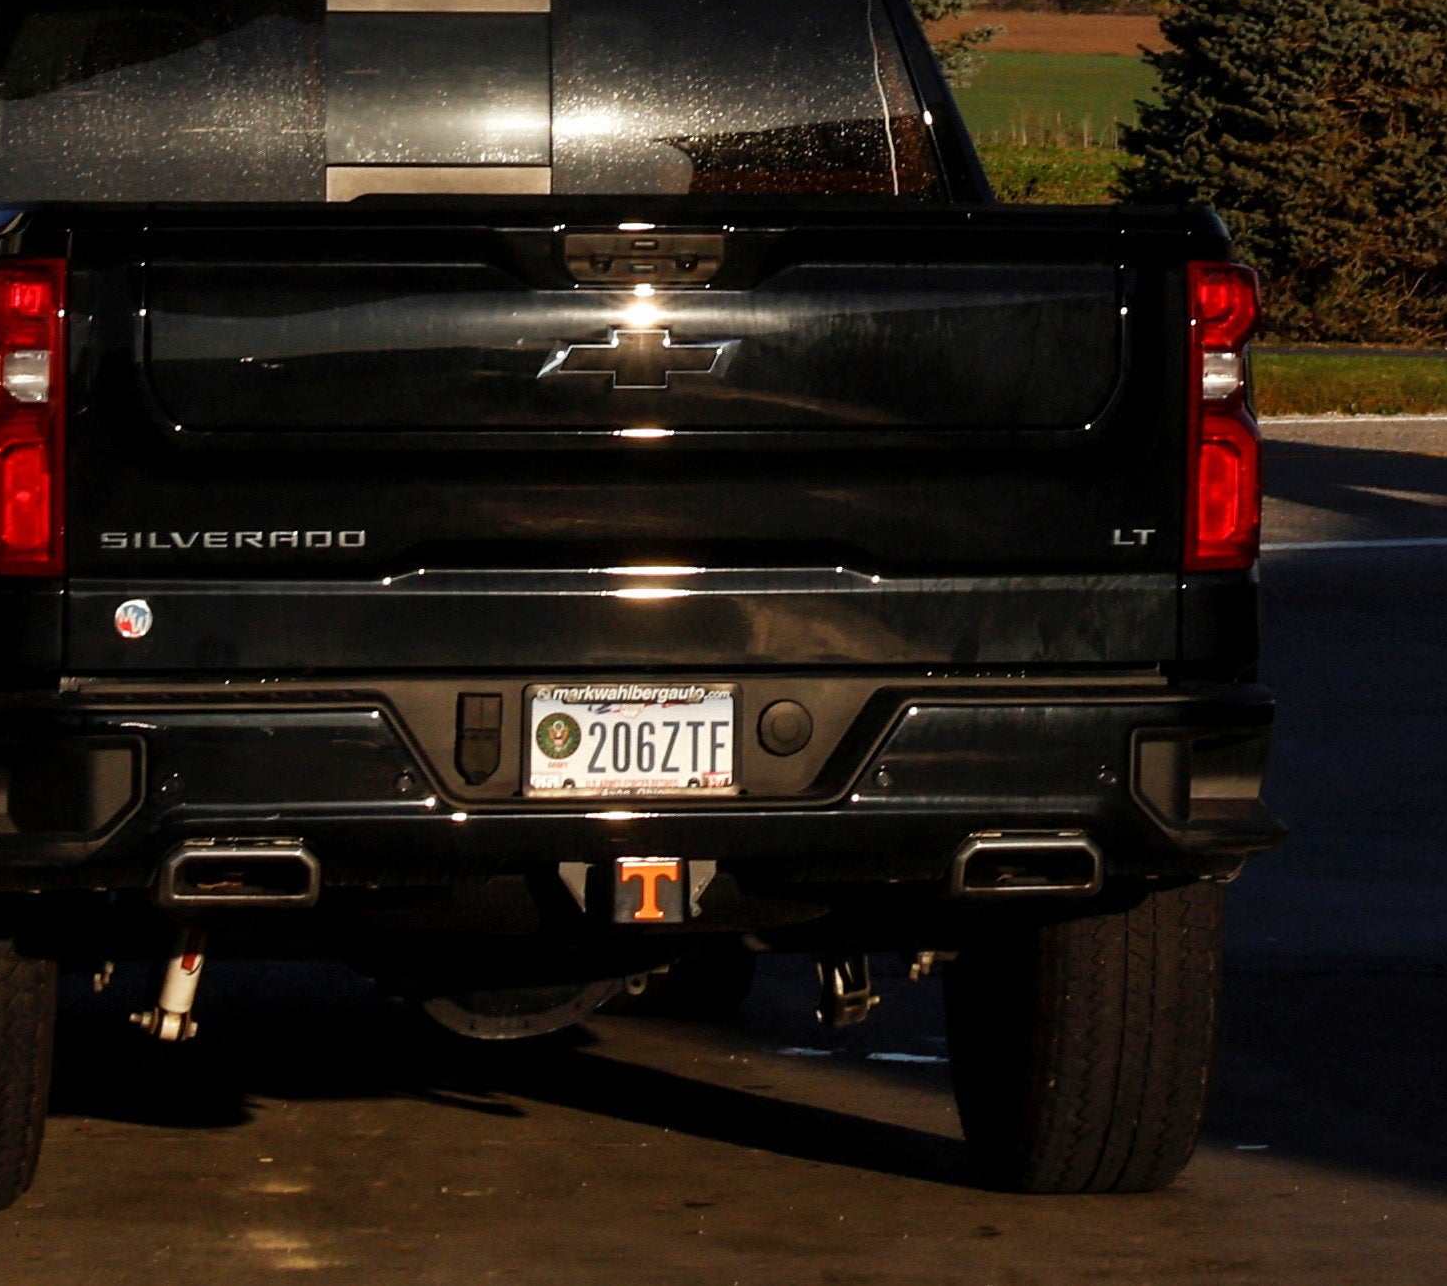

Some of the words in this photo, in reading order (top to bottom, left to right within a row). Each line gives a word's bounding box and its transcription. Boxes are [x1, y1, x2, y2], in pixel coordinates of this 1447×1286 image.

[100, 530, 366, 549] SILVERADO
[1113, 529, 1156, 545] LT
[553, 684, 731, 703] markwahlbergauto.com
[587, 721, 730, 773] 206ZTF
[620, 862, 679, 921] T
